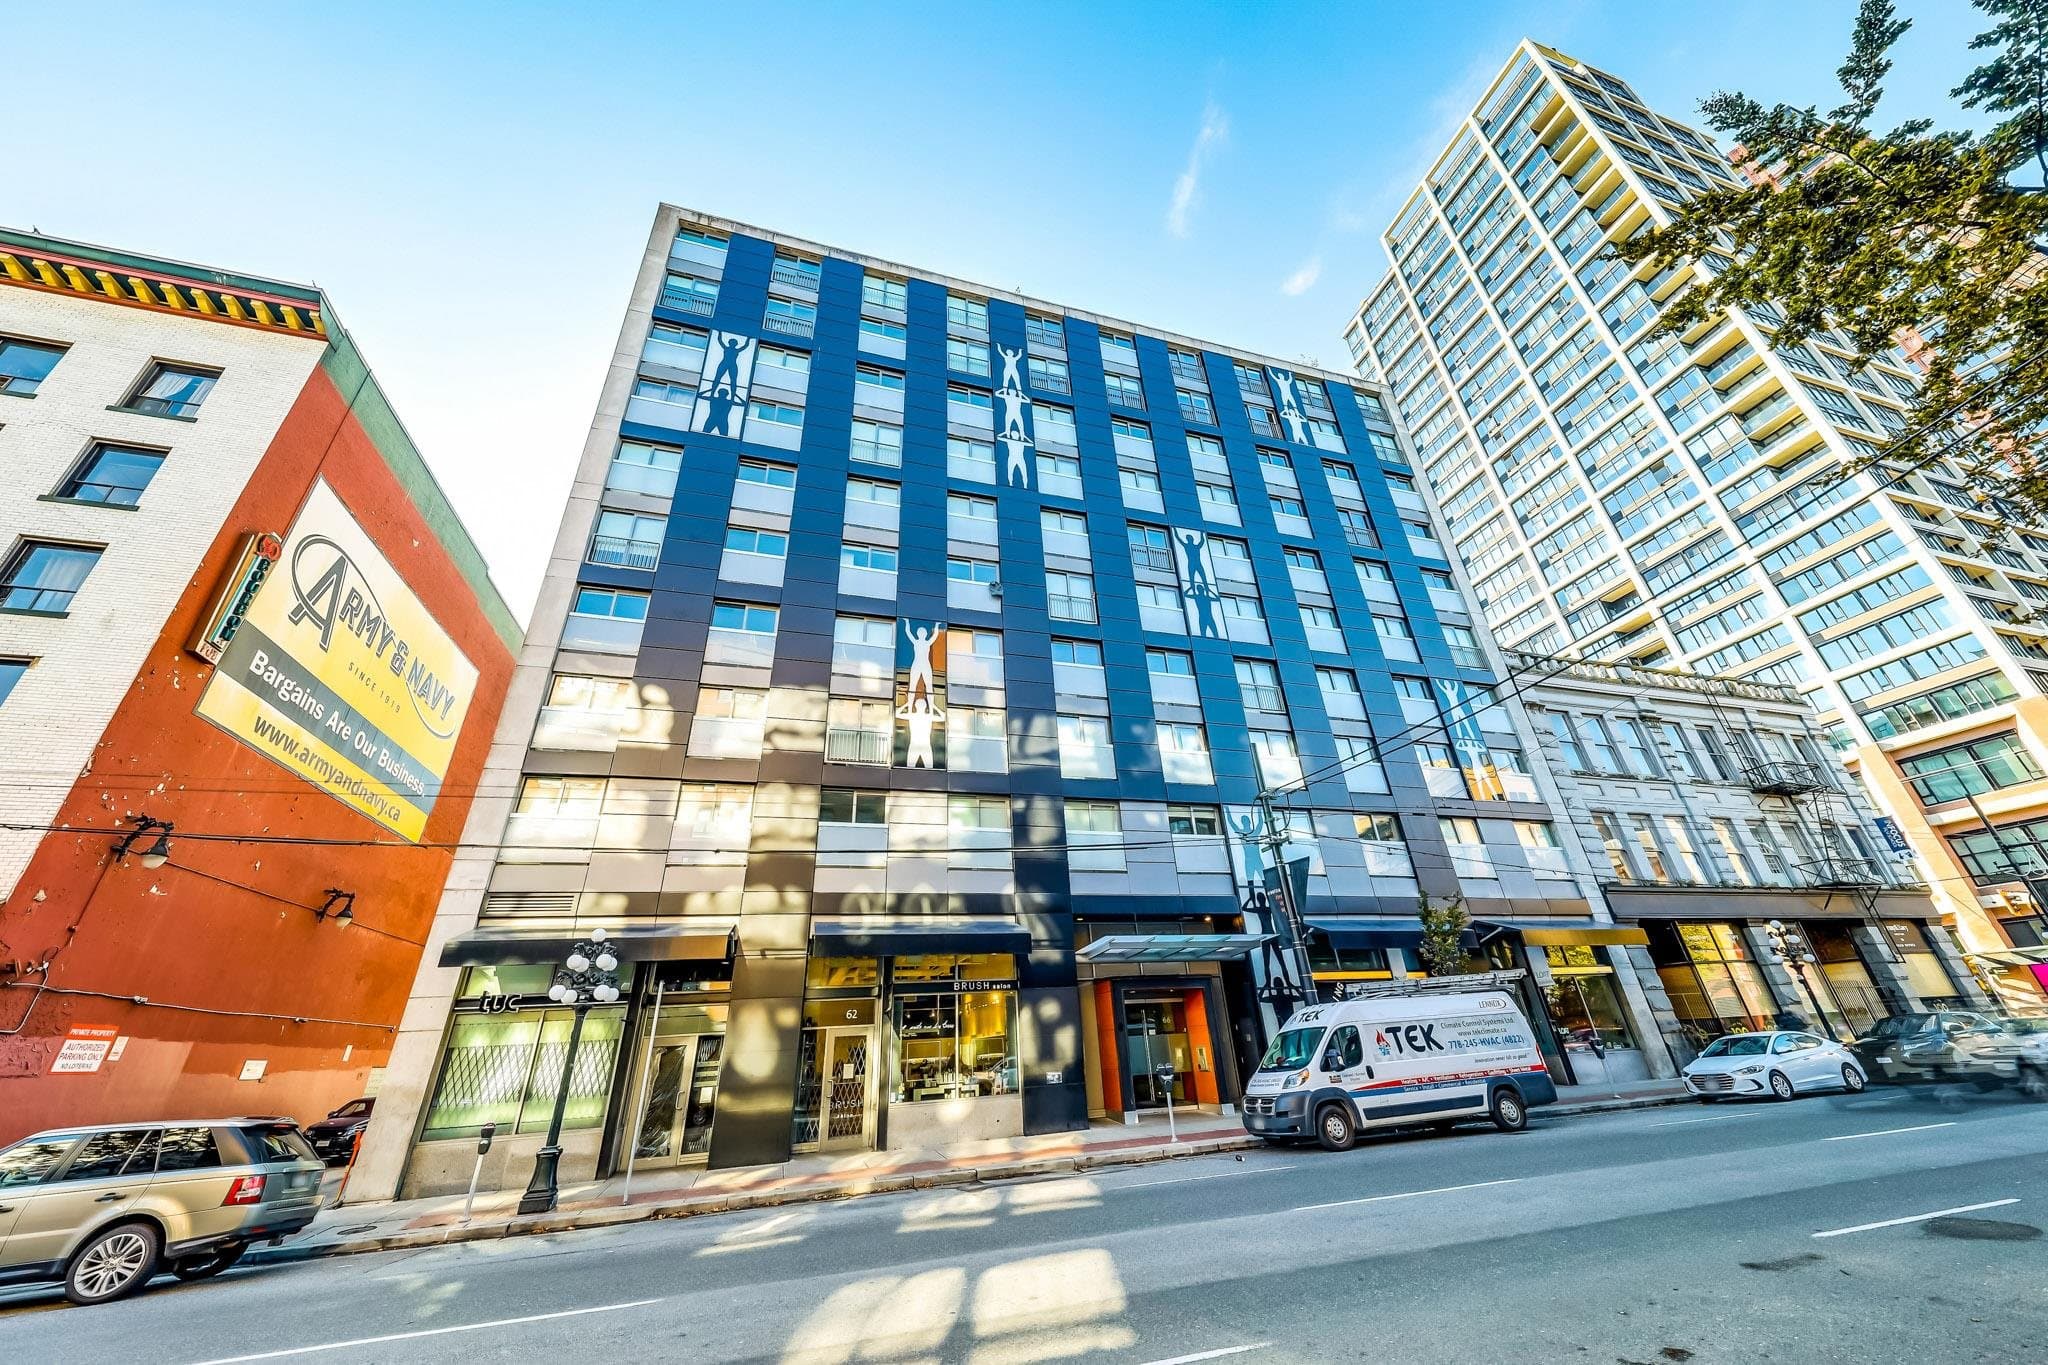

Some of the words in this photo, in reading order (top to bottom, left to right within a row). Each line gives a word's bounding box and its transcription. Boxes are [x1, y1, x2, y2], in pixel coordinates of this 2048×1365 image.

[288, 555, 396, 658] ARMY
[390, 640, 409, 677] &
[407, 656, 455, 720] NAVY
[348, 662, 376, 692] SINCE
[379, 690, 401, 713] 1919
[249, 650, 326, 720] Bargains
[325, 710, 352, 741] Are
[354, 731, 378, 760] Our
[253, 715, 401, 823] www.armyandnavy.ca
[953, 981, 990, 991] BRUSH
[1478, 1000, 1503, 1009] LENNOX
[846, 1009, 858, 1020] 62
[1298, 1009, 1325, 1023] TEK
[1462, 1019, 1482, 1028] Control
[1482, 1017, 1504, 1028] Systems
[1385, 1023, 1445, 1054] TEK
[1448, 1036, 1500, 1050] 778-245-HVAC
[1502, 1034, 1525, 1046] (4822)
[66, 1043, 106, 1051] AUTHORIZED
[59, 1052, 88, 1061] PARKING
[87, 1053, 103, 1061] ONLY
